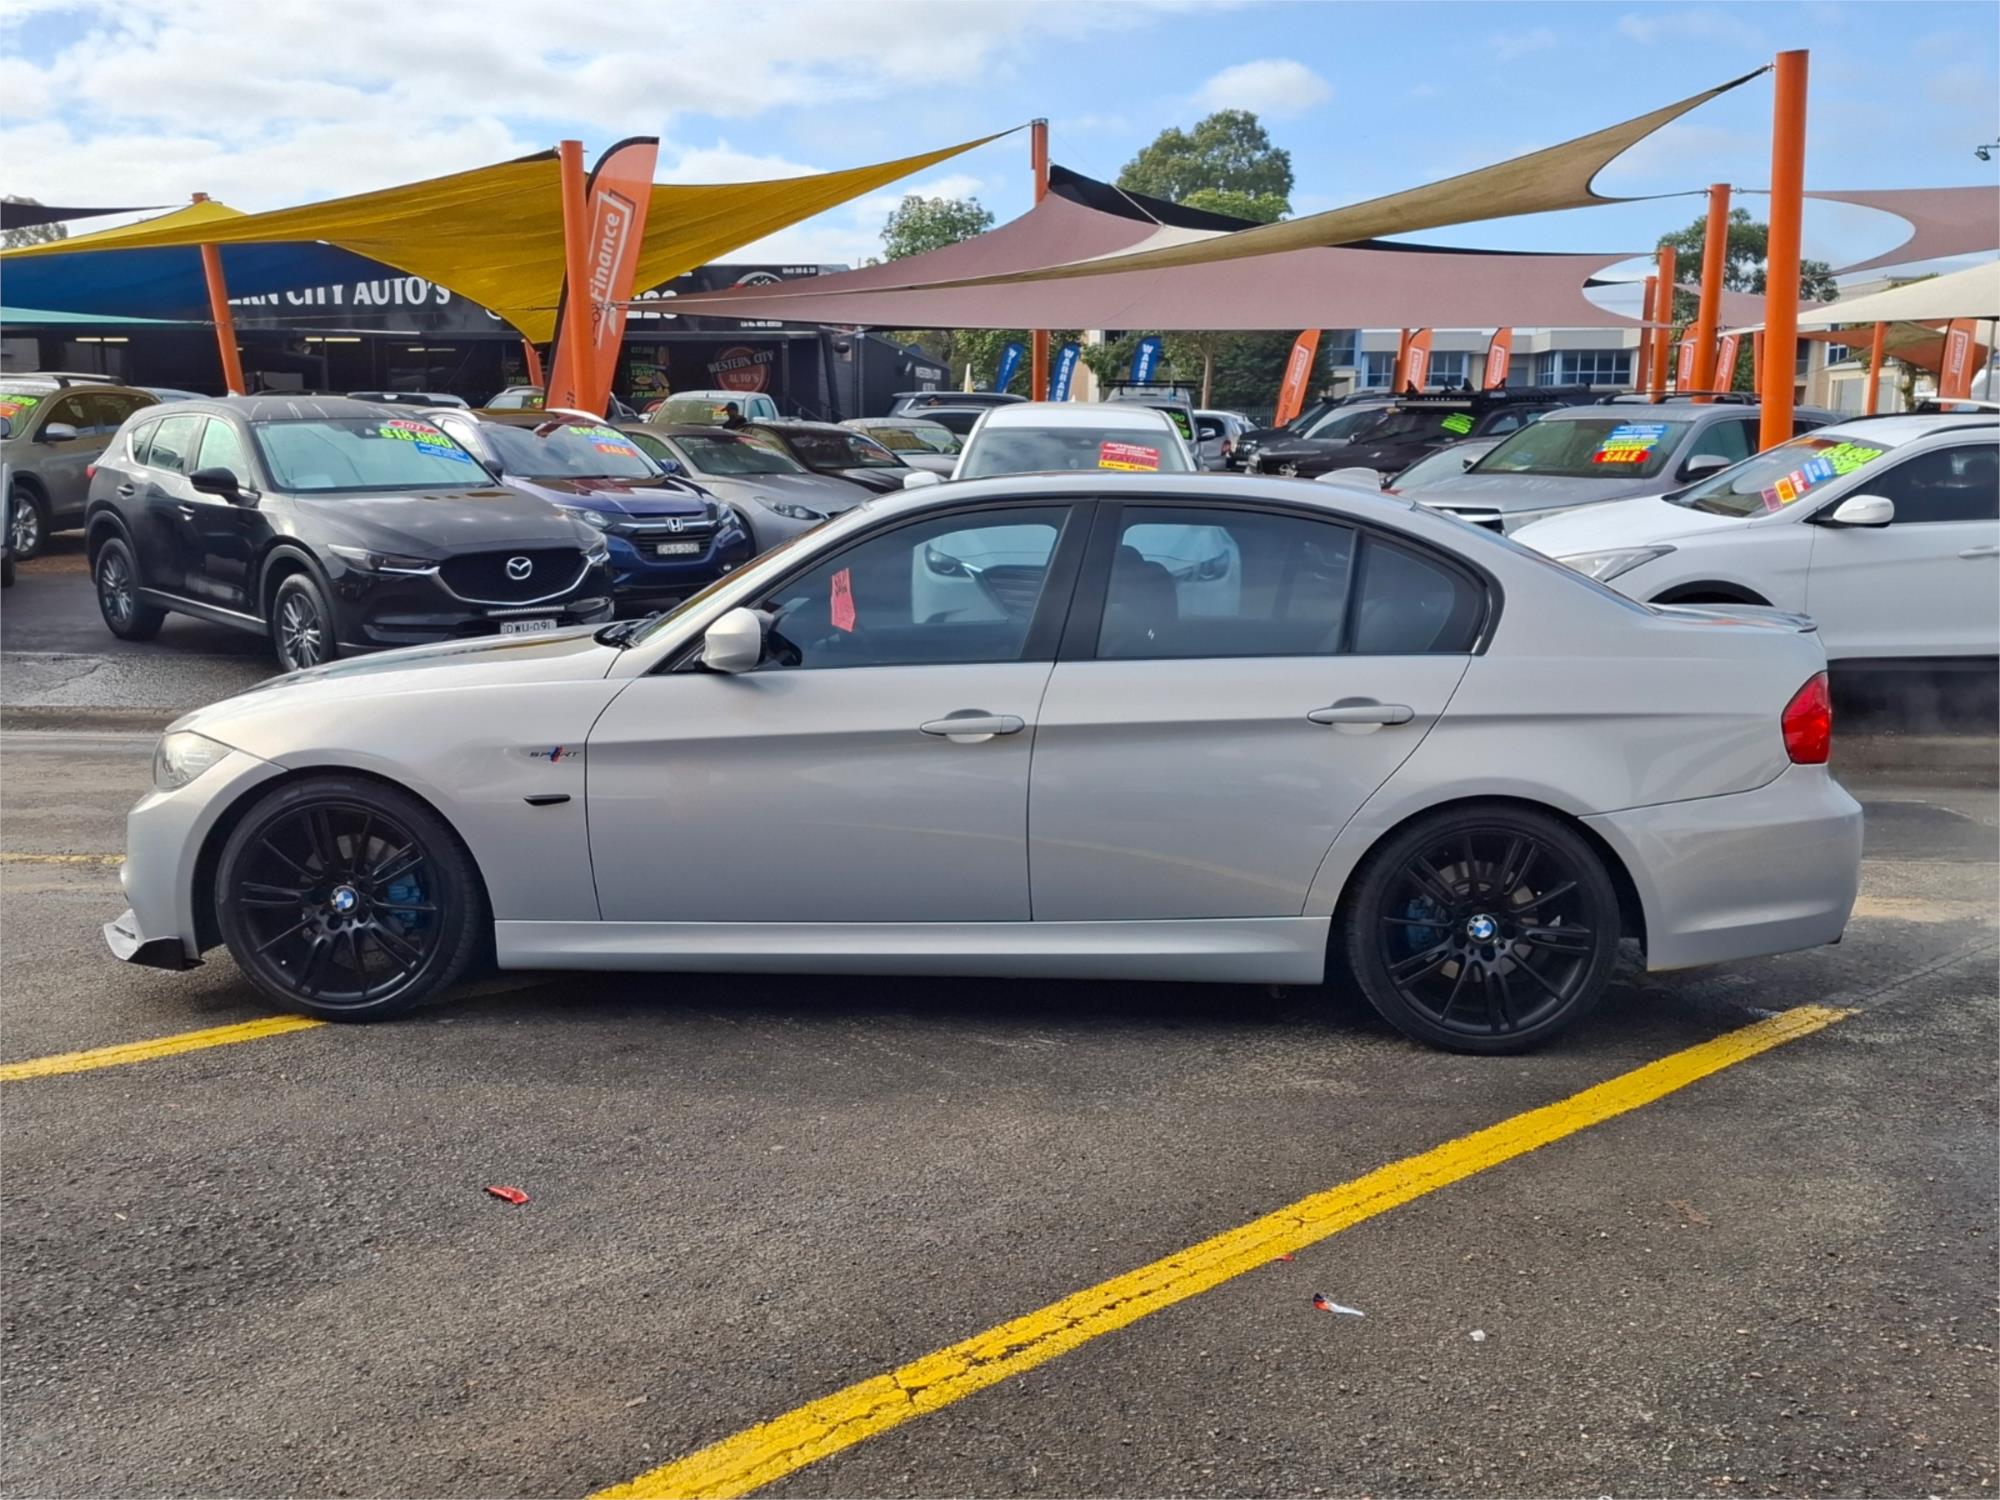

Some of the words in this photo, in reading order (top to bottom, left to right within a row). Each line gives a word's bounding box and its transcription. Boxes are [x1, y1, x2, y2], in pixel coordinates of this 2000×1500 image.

[589, 212, 620, 302] Finance
[353, 276, 451, 305] AUTO'S
[753, 350, 774, 364] CITY
[1137, 343, 1154, 386] WARR
[1602, 450, 1641, 462] SALE
